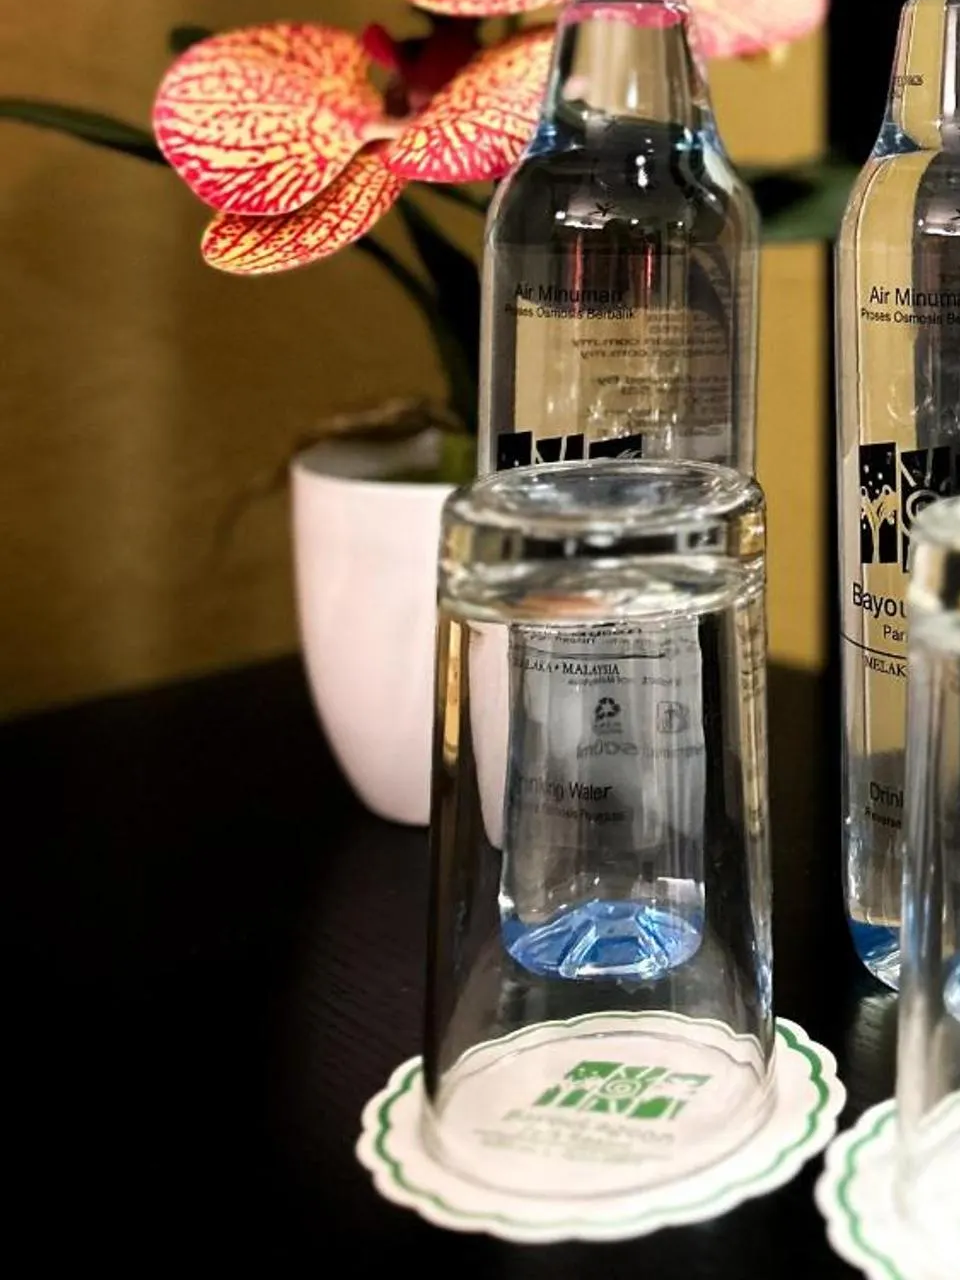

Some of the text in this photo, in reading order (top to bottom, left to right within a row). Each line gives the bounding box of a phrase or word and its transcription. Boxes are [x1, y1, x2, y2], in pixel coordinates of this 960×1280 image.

[514, 283, 624, 304] Air Minuman
[869, 286, 890, 304] Air
[883, 623, 907, 641] Par
[562, 662, 620, 676] MALAYSIA
[863, 656, 907, 678] MELAK
[569, 781, 612, 801] Water
